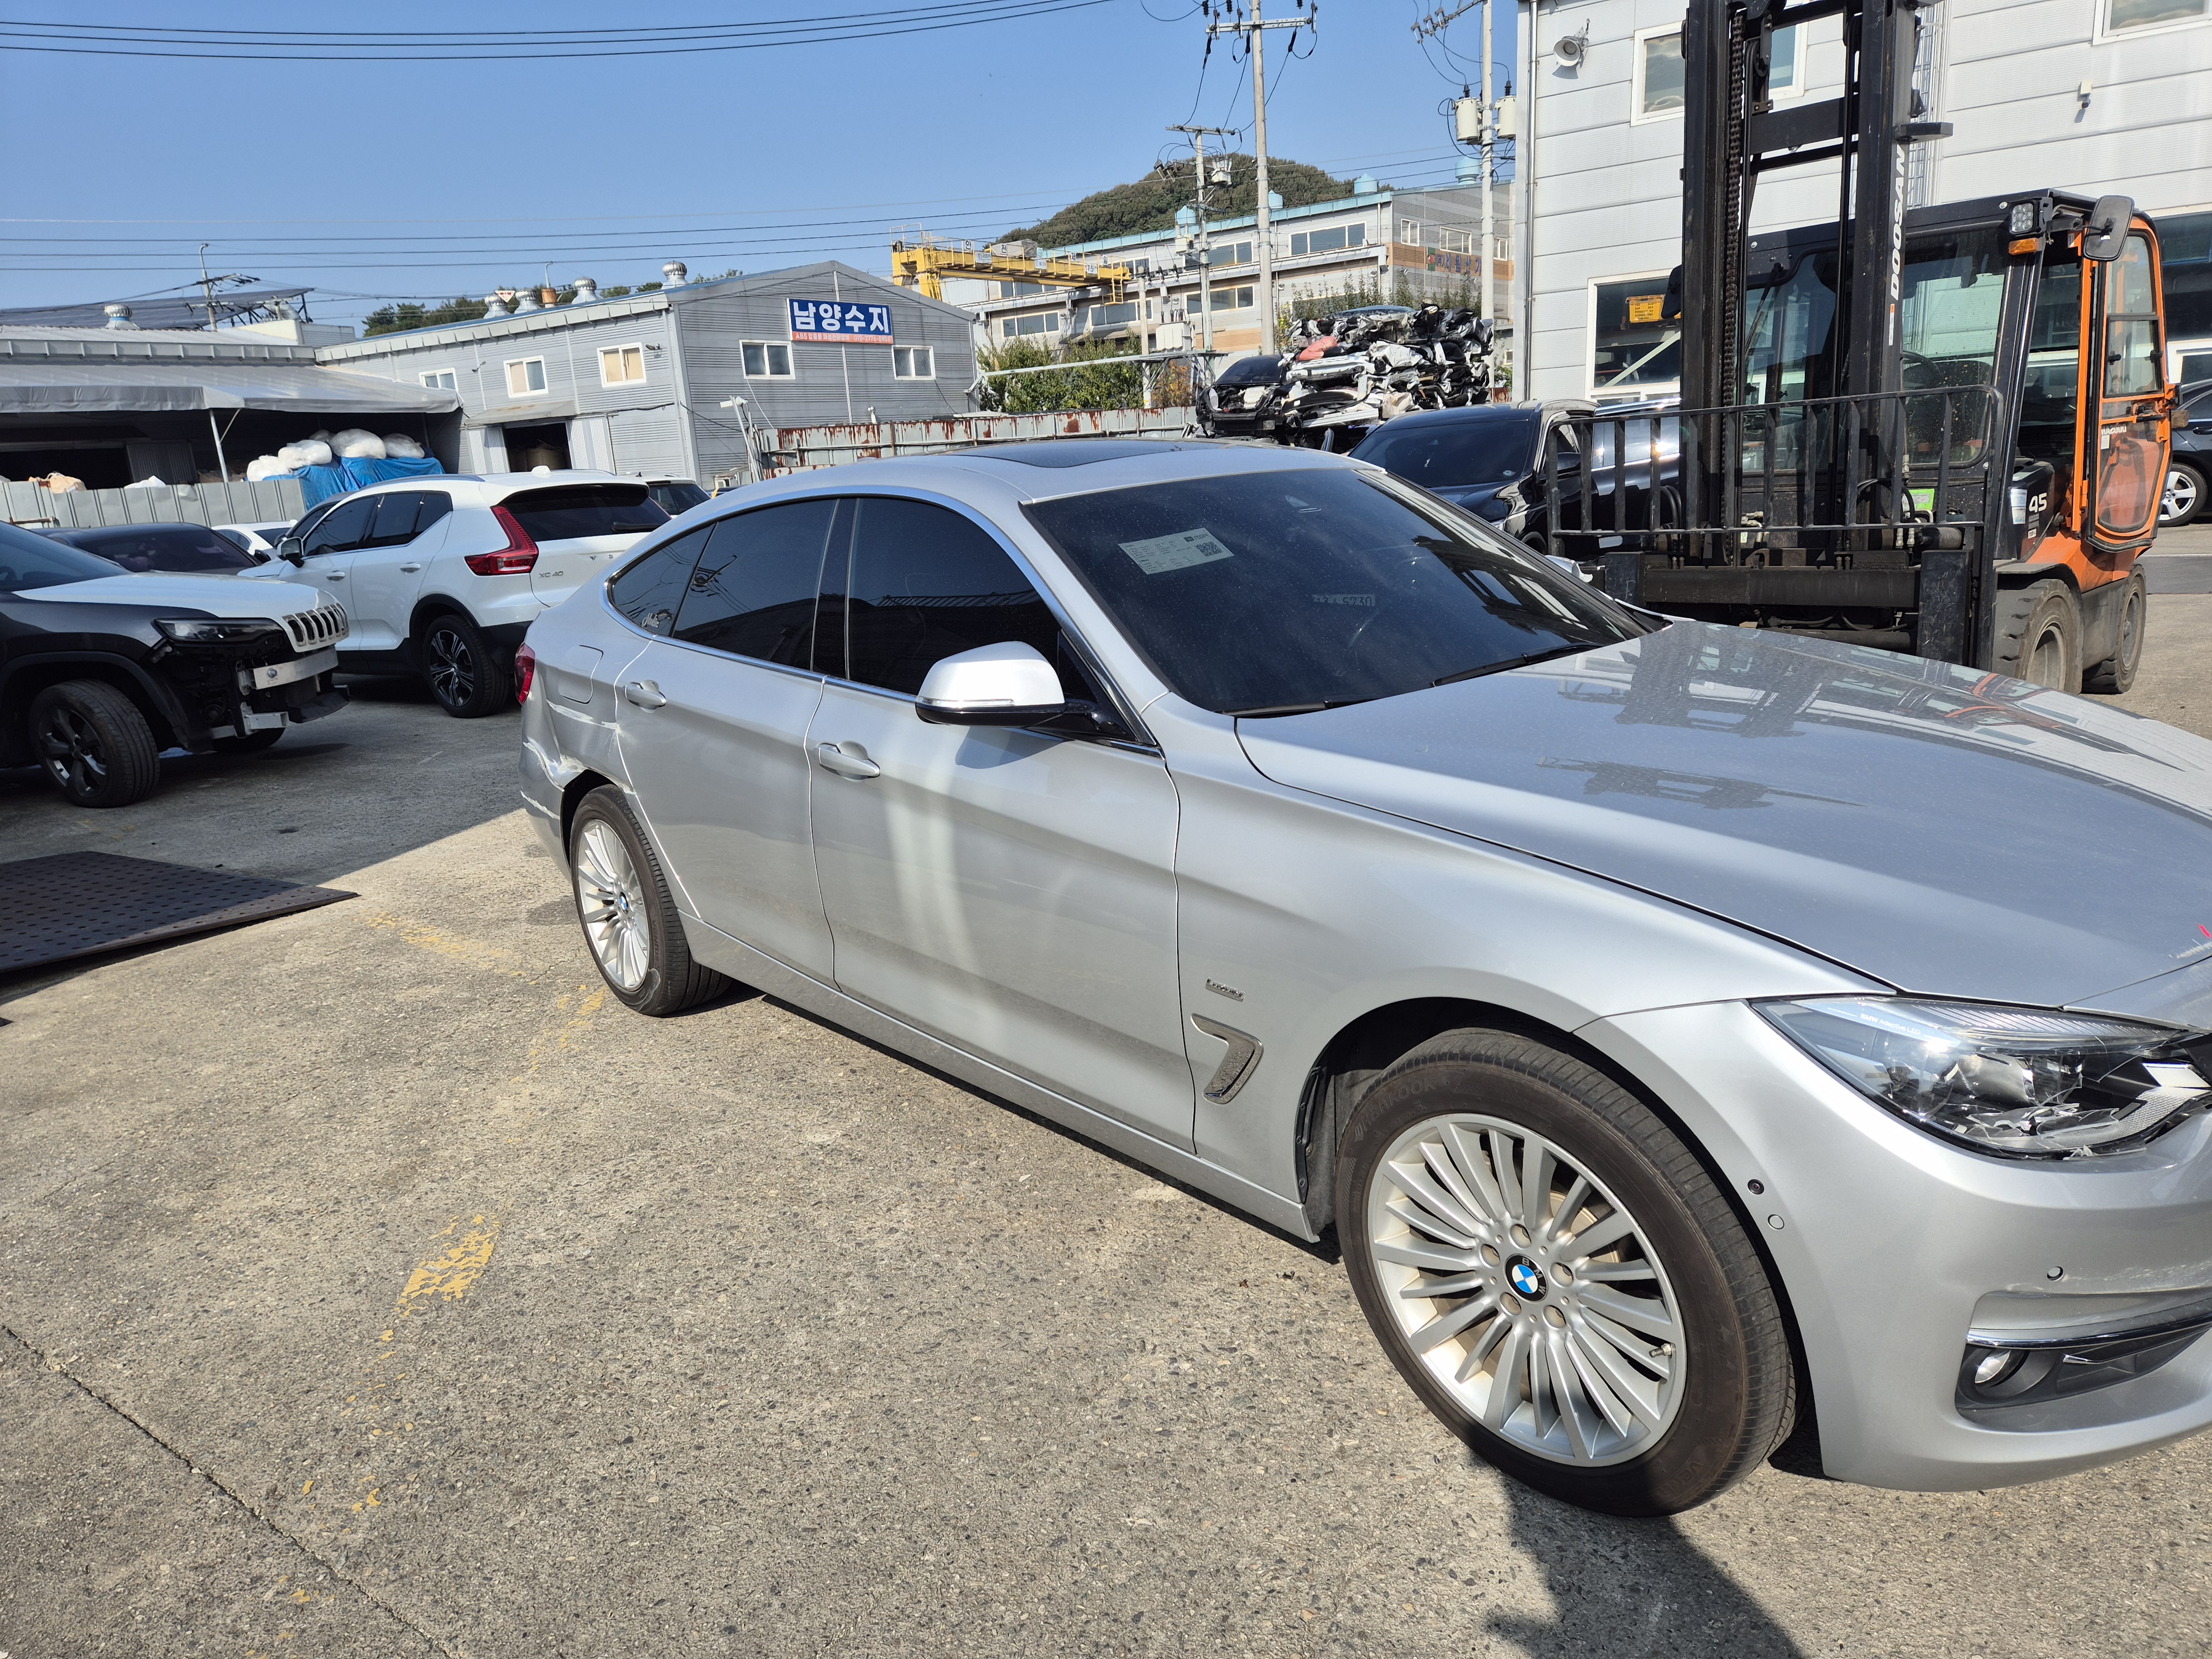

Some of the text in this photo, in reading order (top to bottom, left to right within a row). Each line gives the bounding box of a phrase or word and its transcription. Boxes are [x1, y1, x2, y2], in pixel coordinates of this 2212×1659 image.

[1890, 144, 1906, 301] DOOSAN
[965, 240, 972, 250] 안
[1001, 244, 1007, 254] 전
[792, 301, 889, 333] 남양수지
[2028, 492, 2047, 513] 45
[1860, 1013, 1921, 1035] BMW Adaptive LED
[1522, 1257, 1547, 1295] BMW
